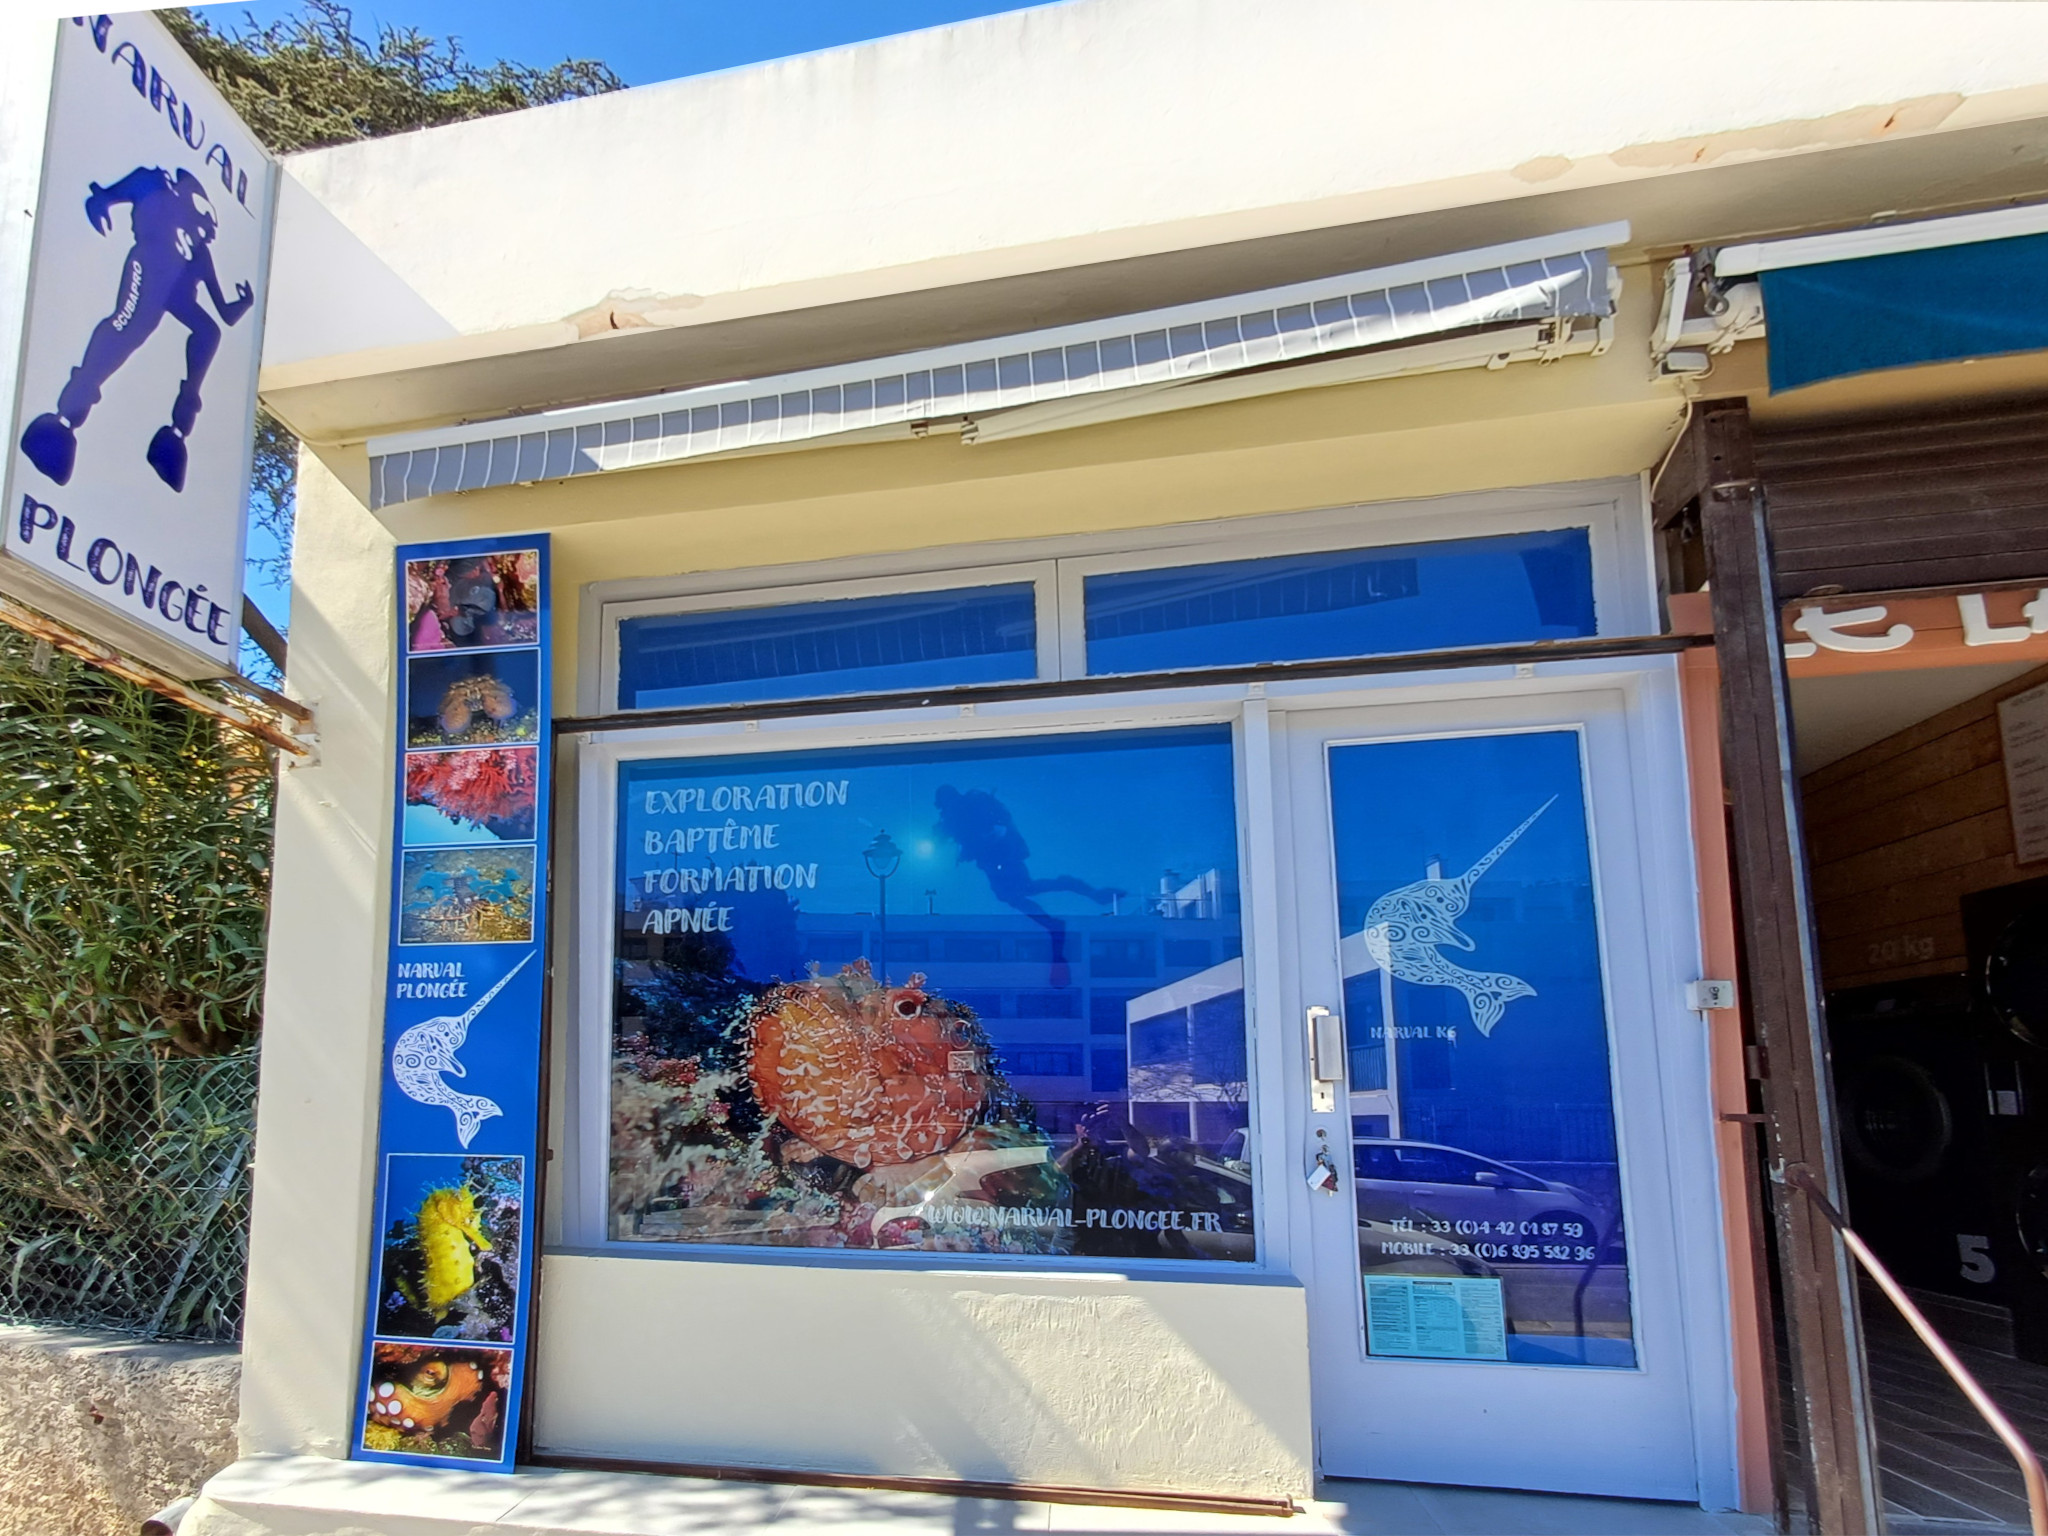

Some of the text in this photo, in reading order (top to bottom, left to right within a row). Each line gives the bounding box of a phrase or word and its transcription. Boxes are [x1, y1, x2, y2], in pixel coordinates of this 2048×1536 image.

[113, 261, 142, 331] SCUBAPRO
[19, 493, 231, 645] PLONGÉE
[645, 780, 849, 814] EXPLORATION
[644, 818, 780, 855] BAPTÊME
[644, 863, 818, 894] FORMATION
[642, 901, 734, 934] APNÉE
[398, 962, 465, 978] NARVAL
[396, 979, 468, 998] PLONGÉE
[1370, 1026, 1432, 1039] NARVAL
[1390, 1217, 1414, 1233] TÉL
[1430, 1219, 1451, 1233] 33
[1455, 1219, 1490, 1235] (0)4
[1495, 1221, 1515, 1236] 42
[1541, 1222, 1558, 1236] 87
[1562, 1222, 1583, 1238] 59
[1381, 1241, 1434, 1256] MOBILE
[1448, 1243, 1470, 1257] 33
[1474, 1242, 1507, 1258] (0)6
[1511, 1243, 1540, 1260] 895
[1542, 1244, 1570, 1260] 582
[1573, 1245, 1596, 1262] 96
[1955, 1232, 1996, 1284] 5
